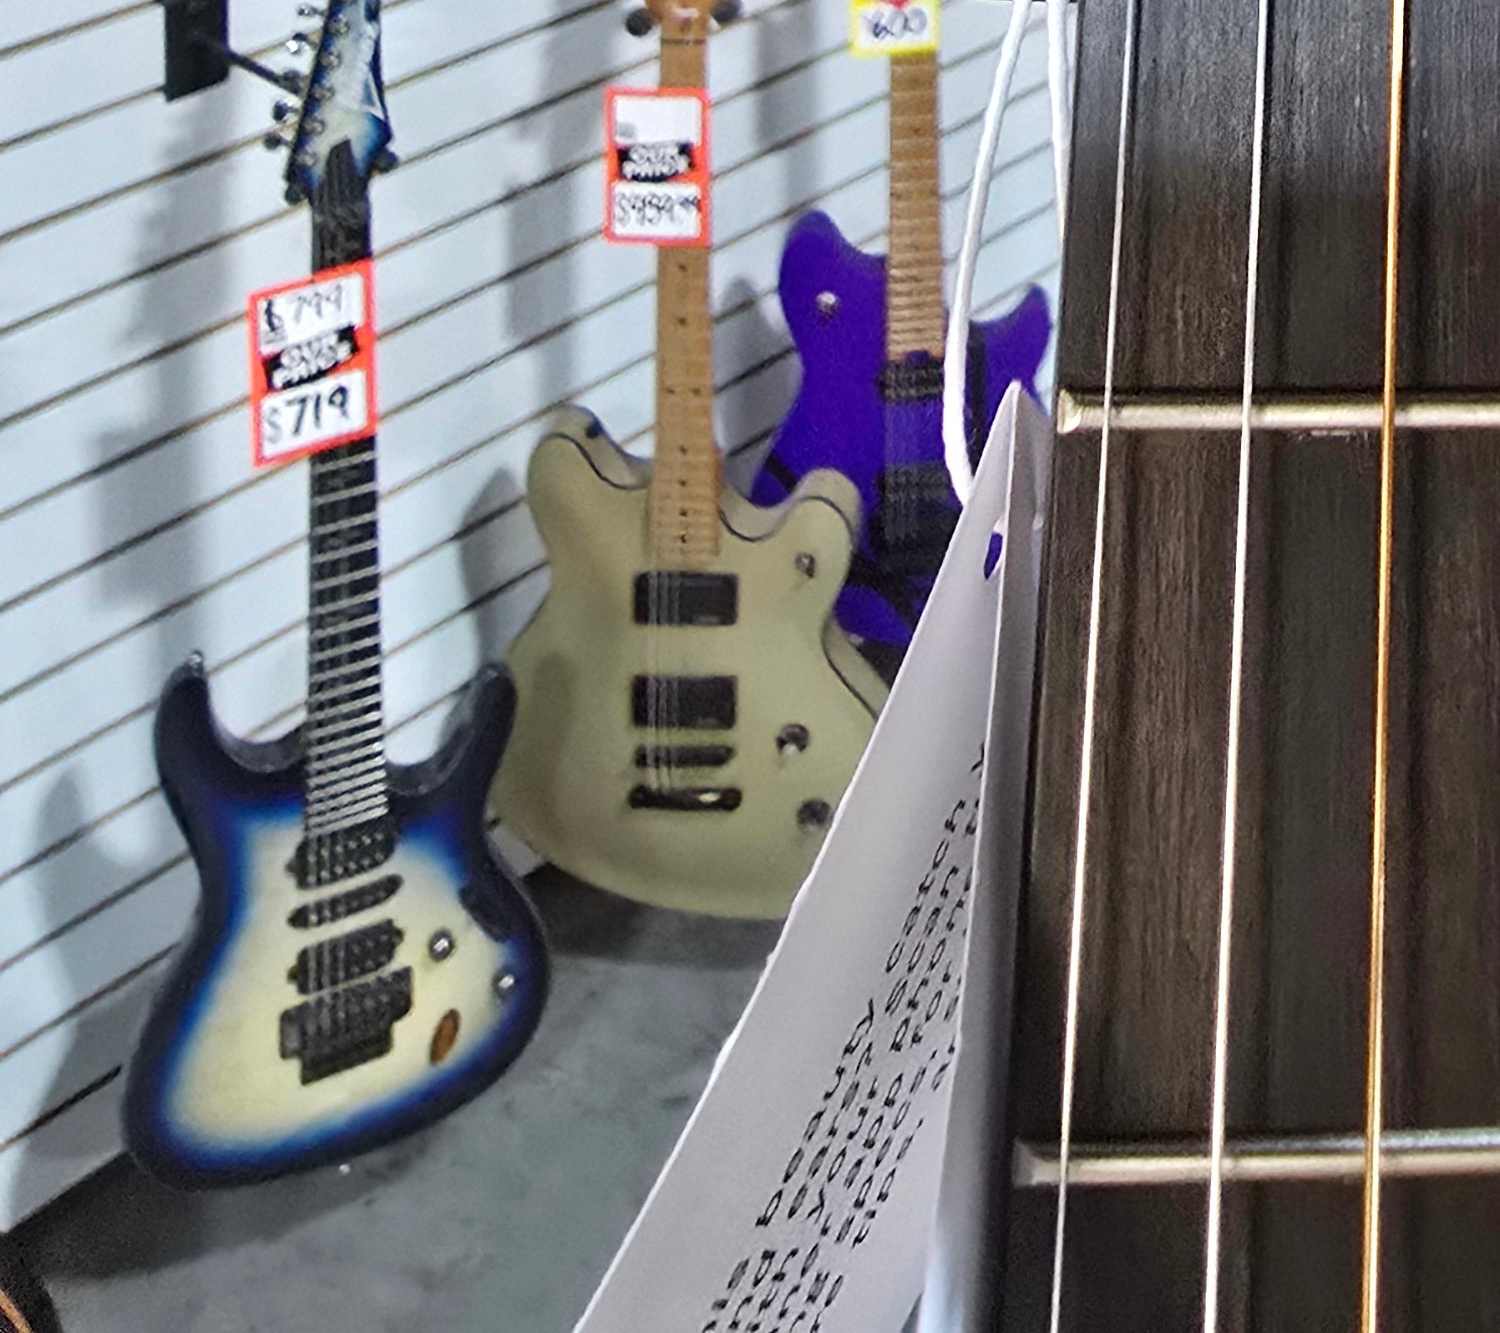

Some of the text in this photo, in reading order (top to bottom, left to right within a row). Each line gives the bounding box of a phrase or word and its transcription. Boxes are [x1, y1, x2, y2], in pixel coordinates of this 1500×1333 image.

[265, 386, 349, 444] $719
[755, 997, 875, 1228] beauty
[885, 799, 964, 975] catch
[883, 865, 960, 1017] Scan
[803, 1075, 881, 1225] your
[843, 1072, 904, 1191] app
